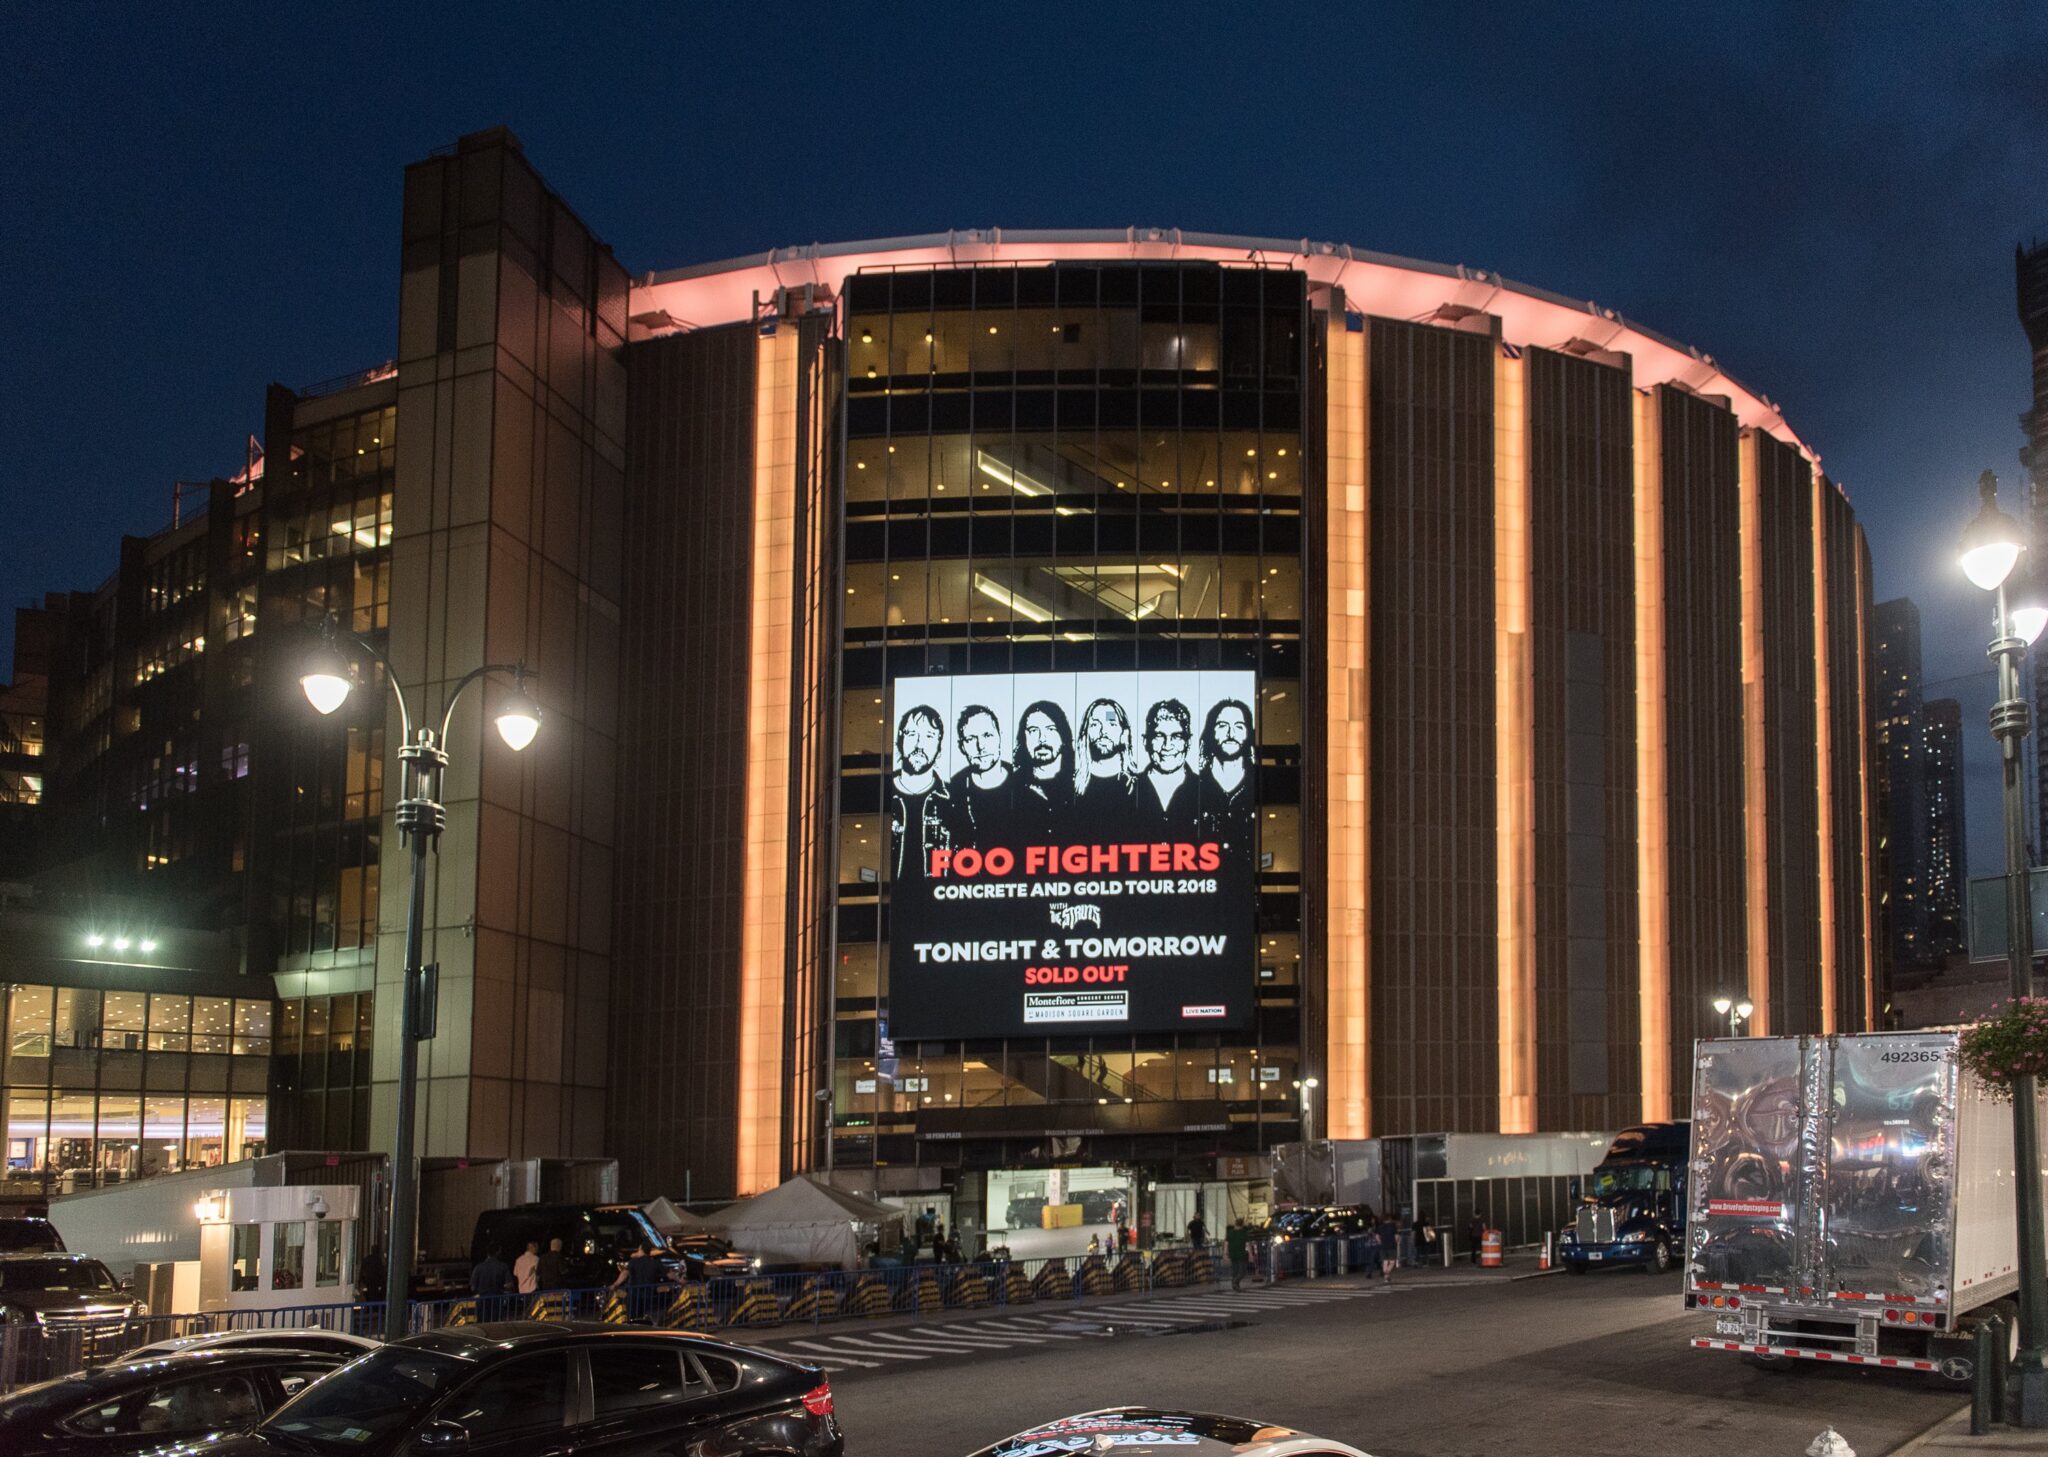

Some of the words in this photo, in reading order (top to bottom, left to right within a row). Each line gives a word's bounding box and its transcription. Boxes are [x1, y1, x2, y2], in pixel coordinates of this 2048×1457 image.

[931, 848, 1014, 877] FOO
[1026, 842, 1220, 875] FIGHTERS
[933, 882, 1028, 899] CONCRETE
[1030, 881, 1071, 897] AND
[1073, 880, 1122, 896] GOLD
[1125, 879, 1175, 895] TOUR
[1177, 878, 1218, 893] 2018
[1061, 904, 1100, 929] STRUTS
[914, 939, 1037, 963] TONIGHT
[1041, 938, 1060, 958] &
[1065, 935, 1227, 958] TOMORROW
[1025, 967, 1079, 984] SOLD
[1082, 965, 1128, 982] OUT
[1028, 995, 1076, 1006] Montefiore
[1035, 1009, 1065, 1018] MADISON
[1068, 1008, 1094, 1018] SQUARE
[1096, 1008, 1123, 1017] GARDEN
[1881, 1051, 1940, 1063] 492365
[1959, 1330, 1974, 1340] Da
